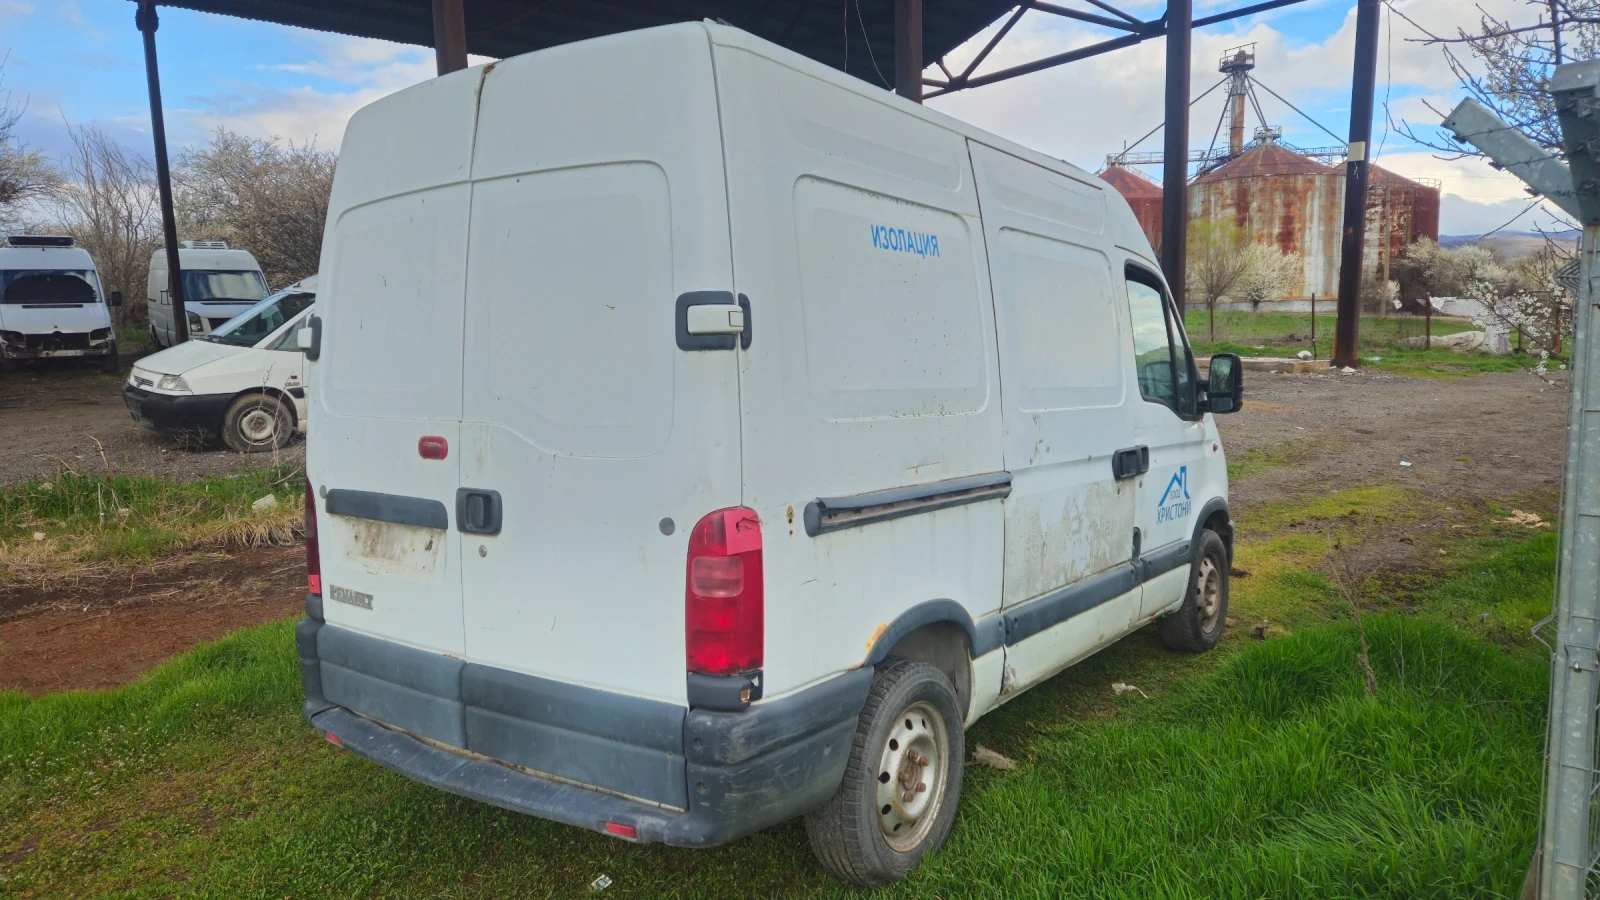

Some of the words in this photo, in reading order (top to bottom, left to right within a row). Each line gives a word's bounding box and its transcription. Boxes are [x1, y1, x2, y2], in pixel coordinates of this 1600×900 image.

[871, 224, 940, 259] ИЗОЛАЦИЯ
[1156, 500, 1192, 525] ХРИСТОНИ
[329, 585, 374, 611] RENAULT
